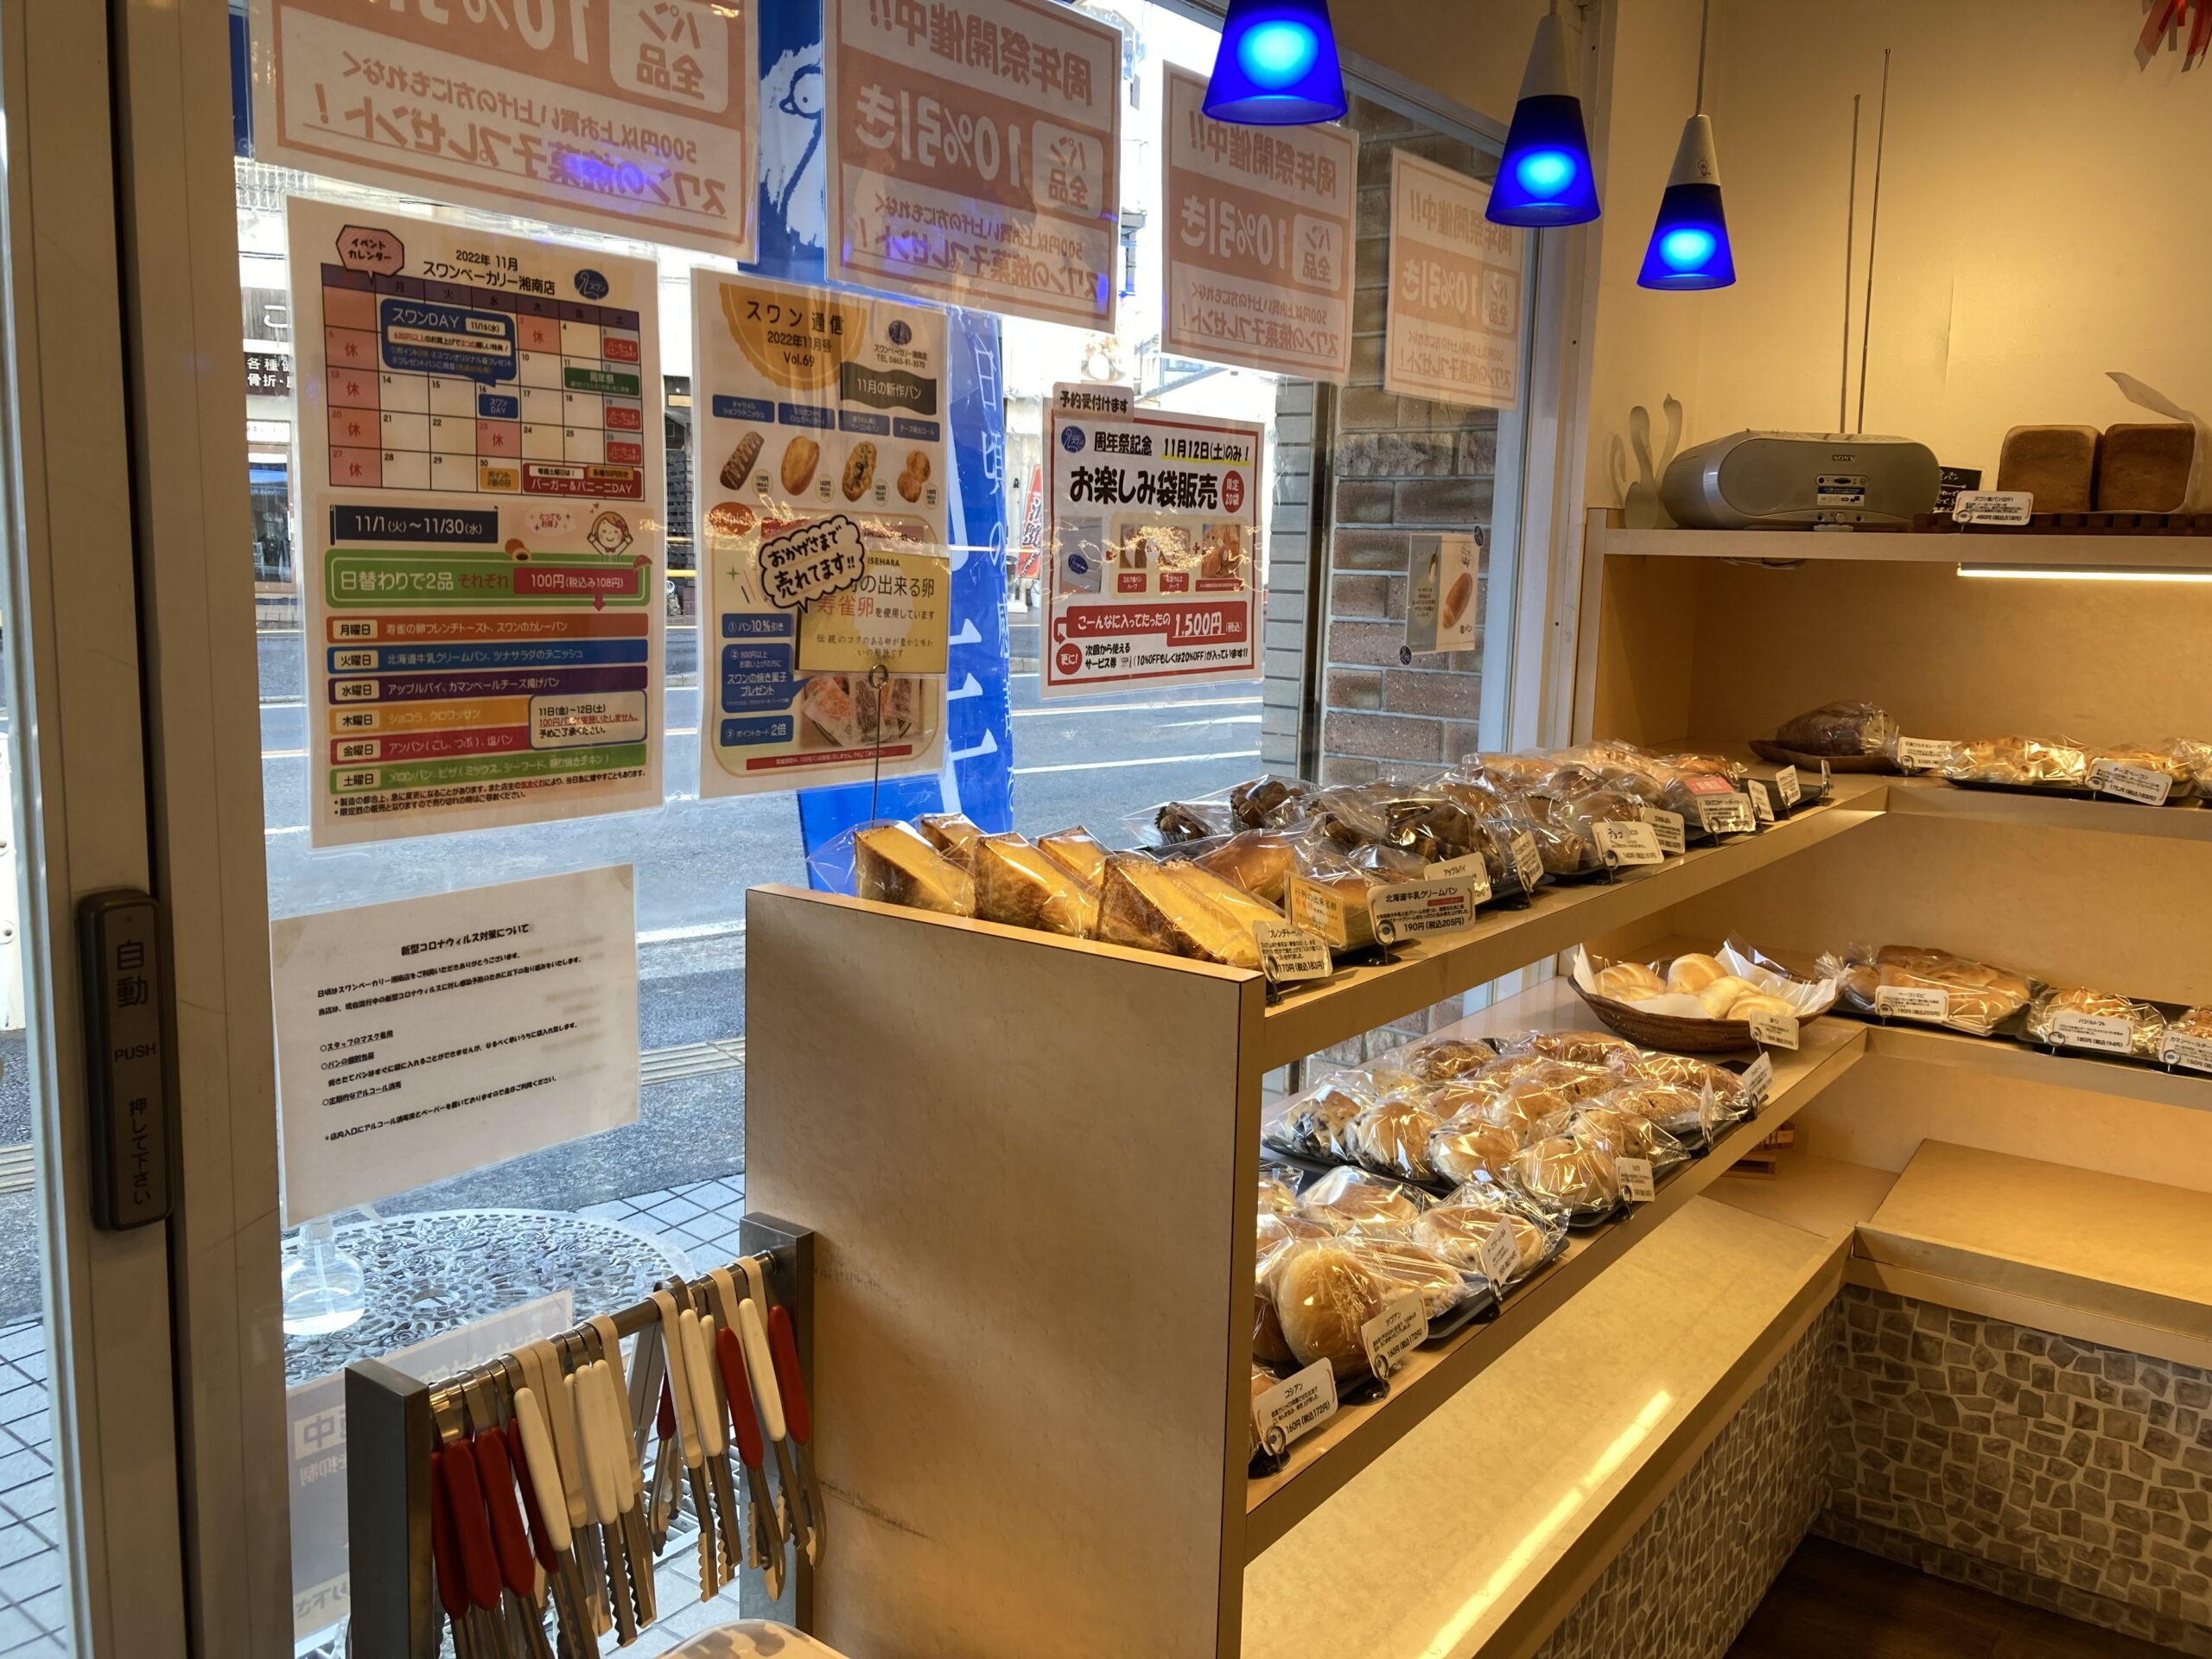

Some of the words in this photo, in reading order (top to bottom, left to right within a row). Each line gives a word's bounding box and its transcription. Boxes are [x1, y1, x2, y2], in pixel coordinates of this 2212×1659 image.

[352, 238, 386, 251] イベント
[348, 250, 392, 262] カレンダー
[455, 250, 491, 266] 2022年
[496, 255, 518, 271] 11月
[423, 260, 555, 296] スワンベーカリー湘南店
[396, 282, 404, 293] 月
[443, 289, 453, 300] 火
[392, 308, 460, 328] スワンDAY
[471, 321, 500, 333] 11/16(水)
[747, 300, 844, 335] スワン通信
[532, 329, 546, 344] 休
[767, 332, 832, 353] 2022年11月号
[345, 342, 359, 358] 休
[522, 353, 530, 361] 10
[783, 352, 815, 367] Vol.69
[383, 375, 391, 384] 14
[346, 382, 360, 397] 休
[857, 378, 922, 399] 11月の新作パン
[490, 398, 508, 407] スワン
[1060, 391, 1128, 414] 予約受付けます
[491, 406, 506, 415] DAY
[433, 418, 442, 427] 22
[348, 422, 361, 437] 休
[493, 433, 504, 446] 休
[1094, 431, 1153, 456] 周年祭記念
[349, 462, 362, 477] 休
[1070, 465, 1218, 510] お楽しみ袋販売
[768, 526, 842, 567] おかげさまで
[868, 558, 900, 567] ISEHARA
[340, 570, 454, 592] 日替わりで2品
[459, 574, 509, 589] それぞれ
[853, 575, 935, 598] の出来る卵
[1077, 612, 1171, 630] こーんなに入ってたったの
[340, 624, 371, 636] 月曜日
[1085, 642, 1131, 656] 次回から使える
[340, 655, 372, 666] 火曜日
[1085, 658, 1117, 670] サービス券
[341, 684, 372, 696] 水曜日
[741, 684, 775, 696] プレゼント
[342, 714, 372, 726] 木曜日
[343, 744, 373, 757] 金曜日
[343, 773, 374, 786] 土曜日
[1385, 887, 1457, 902] 北海道牛乳クリームパン
[401, 924, 530, 957] 新型コロナウィルス対策について
[116, 938, 149, 1008] 自動
[114, 1043, 156, 1063] PUSH
[129, 1097, 152, 1206] 押して下さい
[1284, 1382, 1304, 1398] コシアン
